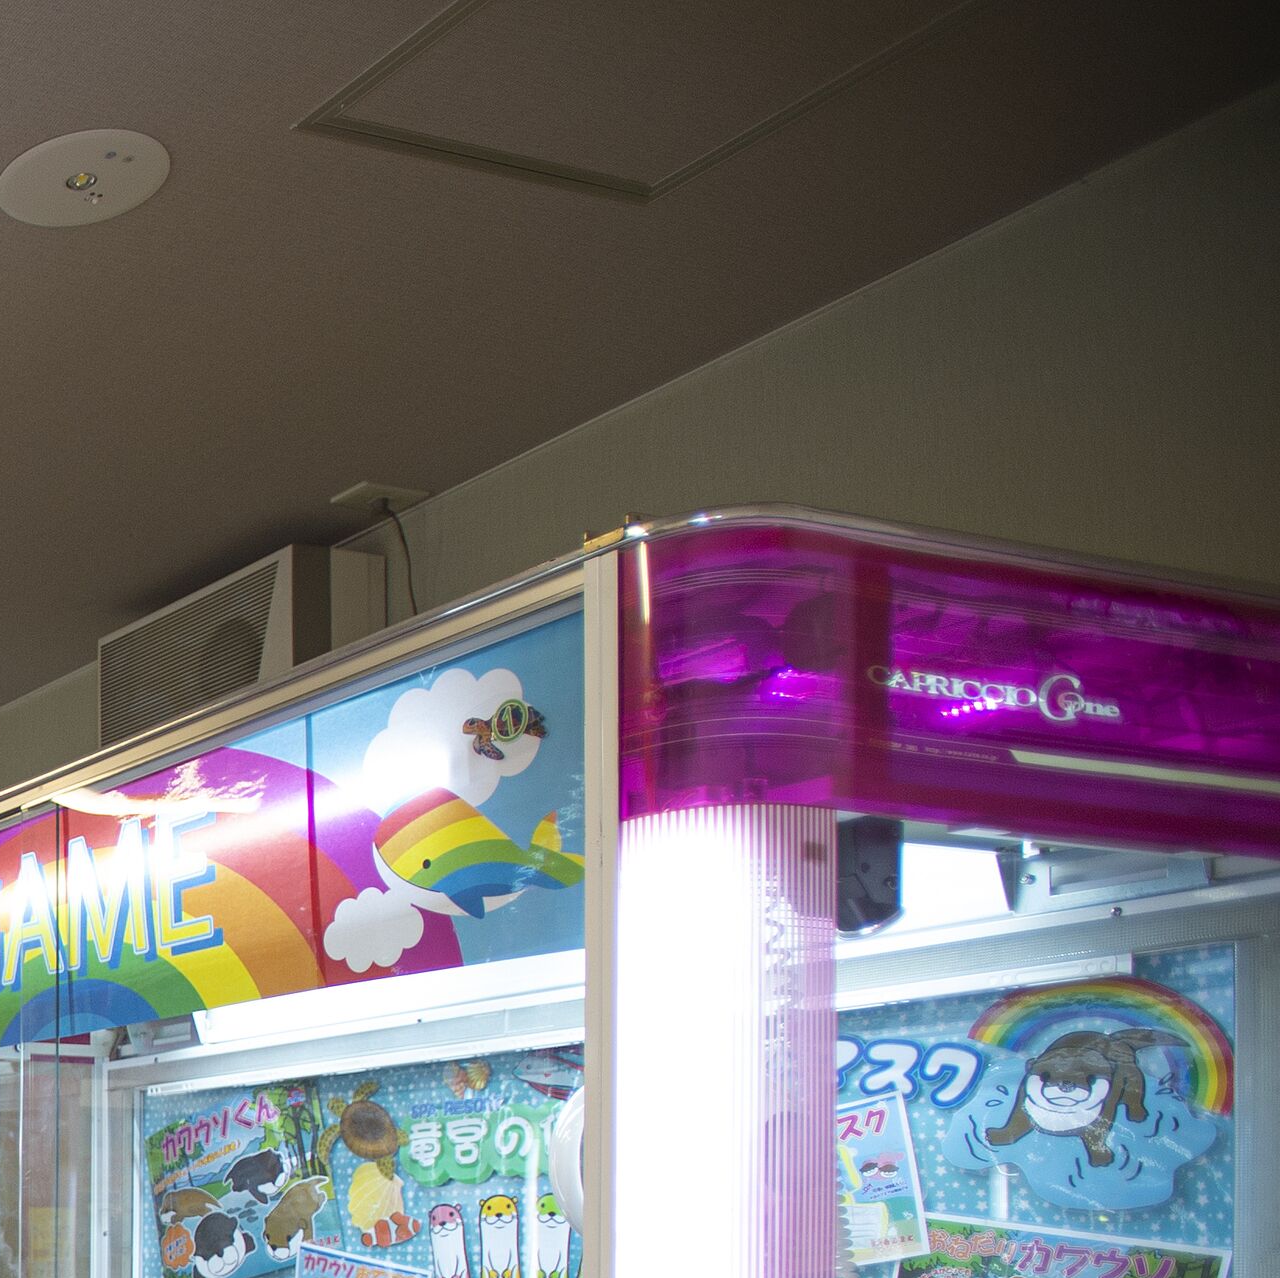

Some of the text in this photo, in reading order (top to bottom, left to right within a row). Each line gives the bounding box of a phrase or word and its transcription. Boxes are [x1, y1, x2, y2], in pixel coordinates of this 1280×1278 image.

[161, 1094, 280, 1163] カワウソくん
